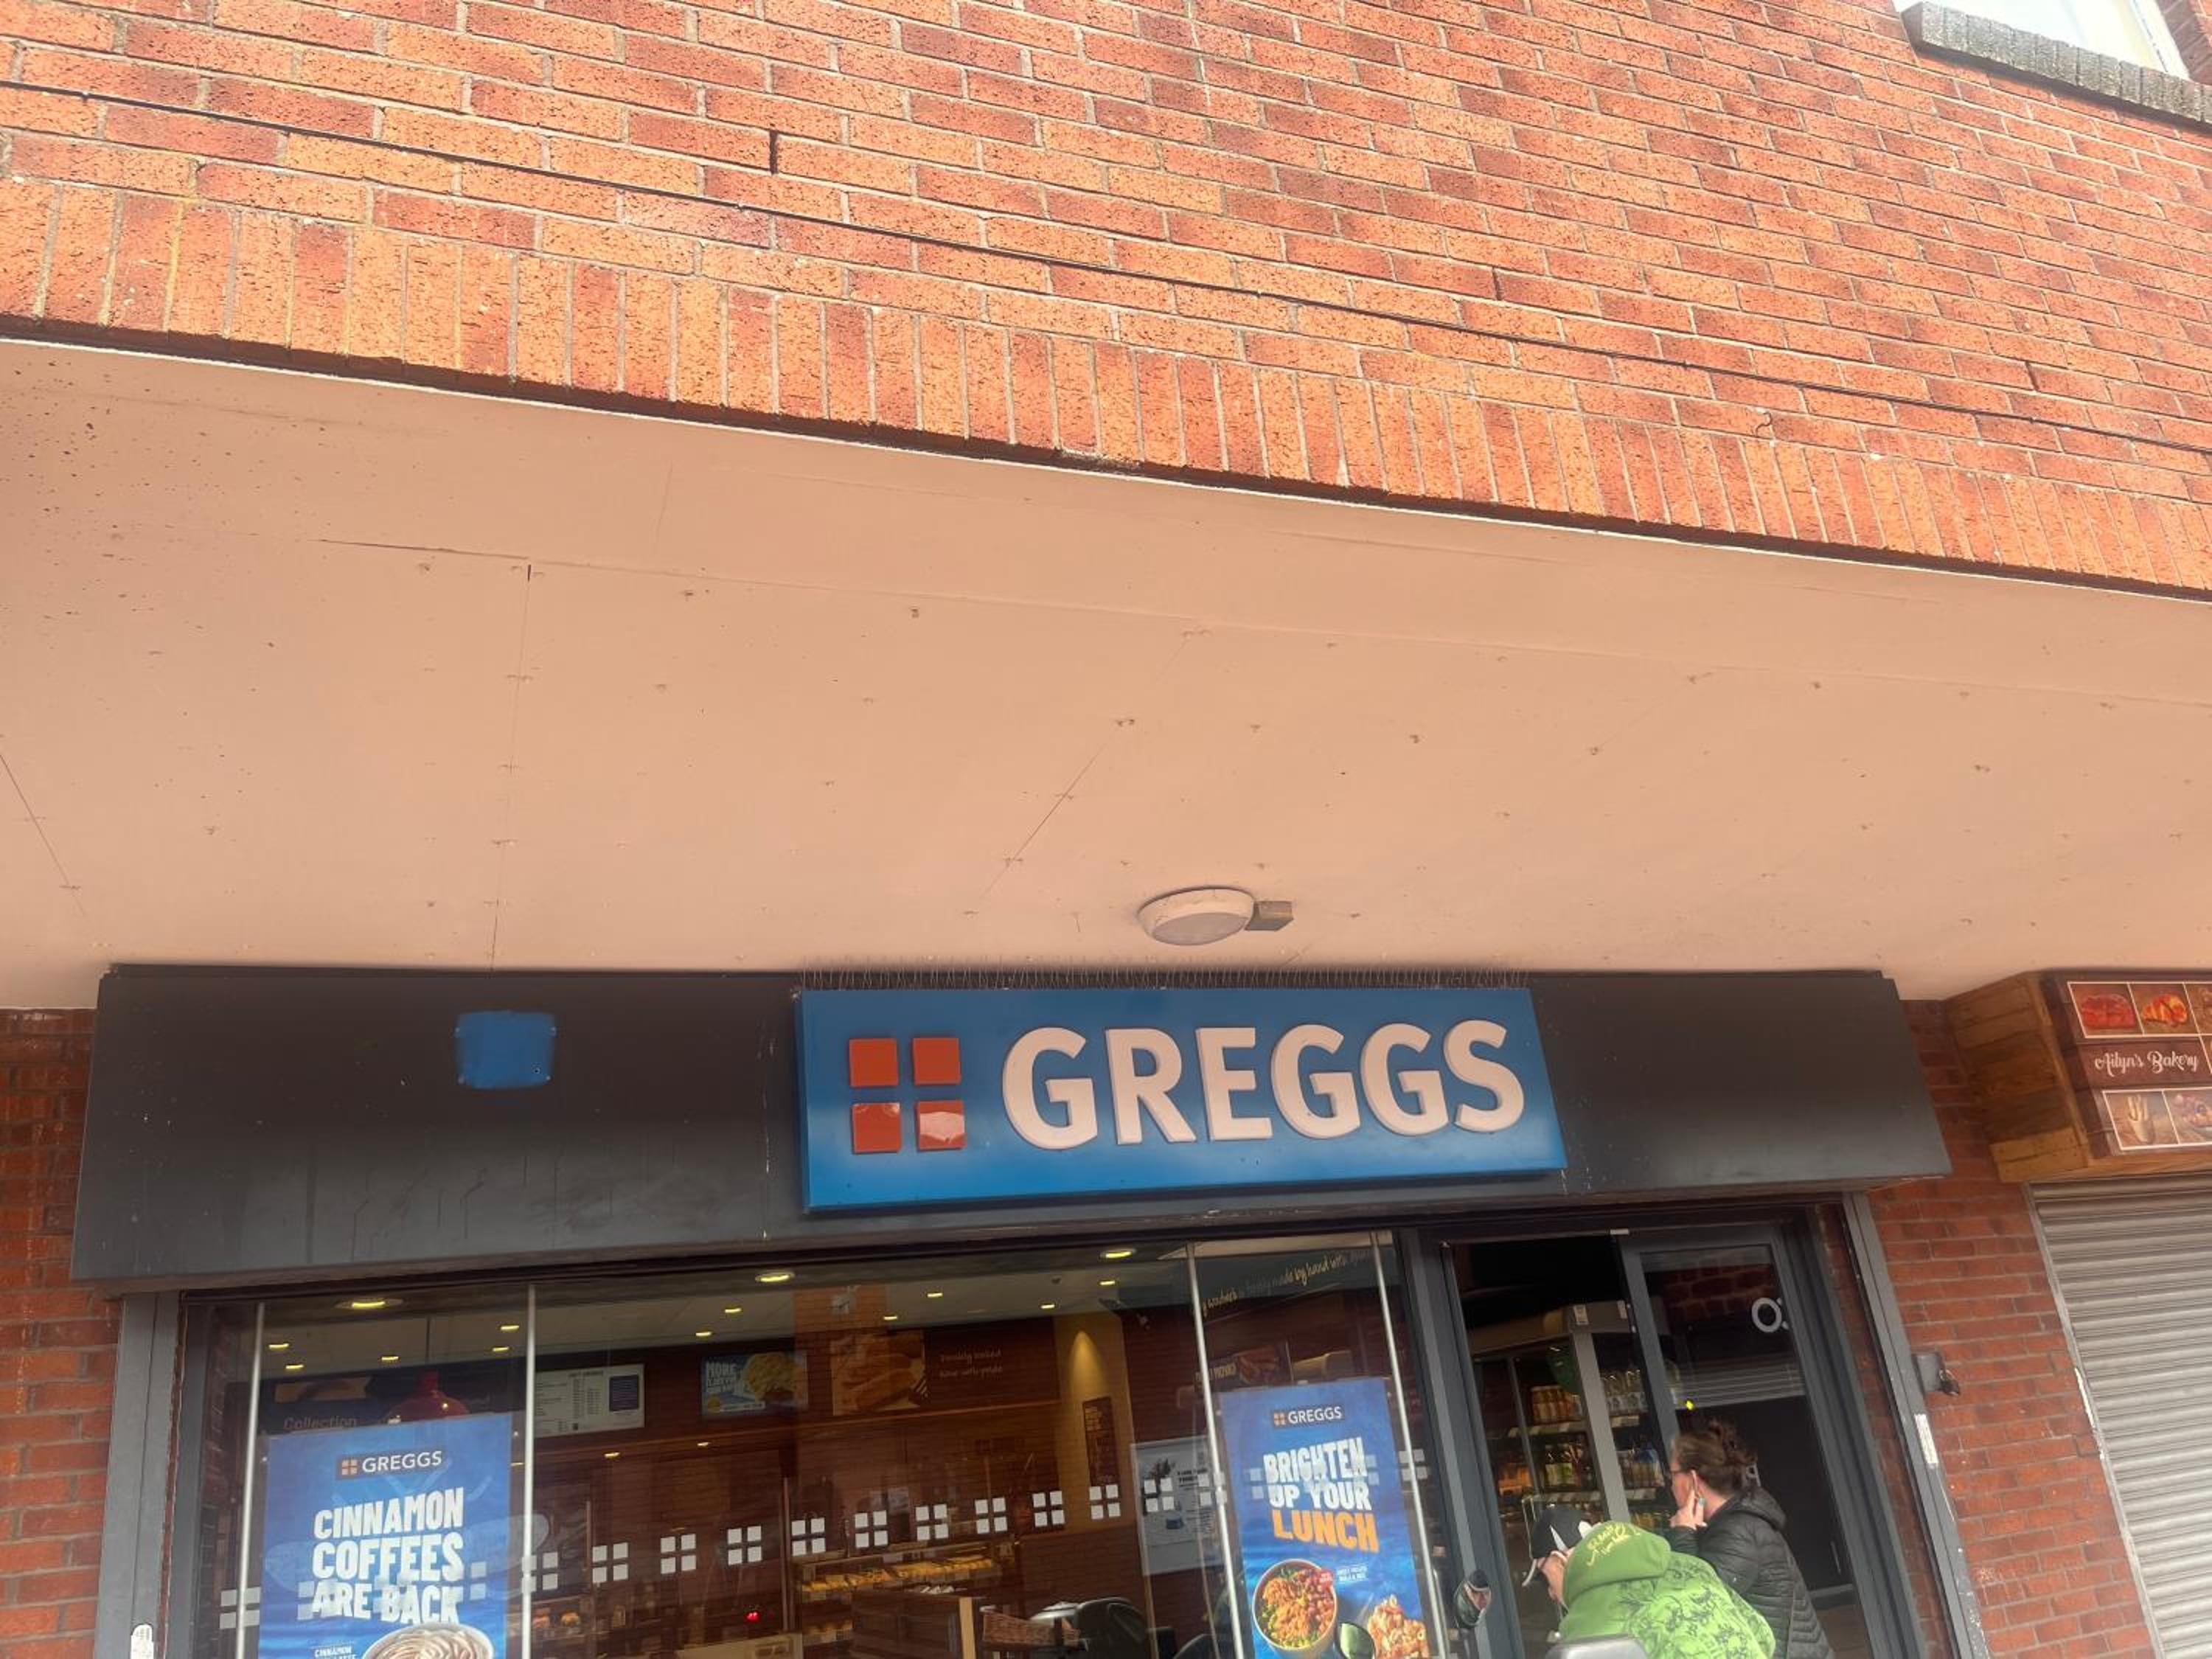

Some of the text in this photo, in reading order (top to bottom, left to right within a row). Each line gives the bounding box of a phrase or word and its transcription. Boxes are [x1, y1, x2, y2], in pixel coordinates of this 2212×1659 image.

[1002, 1019, 1526, 1151] GREGGS
[2146, 1051, 2198, 1074] Bakery
[1287, 1406, 1343, 1425] GREGGS
[361, 1450, 442, 1473] GREGGS
[1262, 1436, 1368, 1484] BRIGHTEN
[313, 1486, 465, 1540] CINNAMON
[1267, 1480, 1372, 1511] UP YOUR
[1271, 1509, 1380, 1554] LUNCH
[312, 1531, 465, 1582] COFFEES
[312, 1579, 465, 1625] ARE BACK
